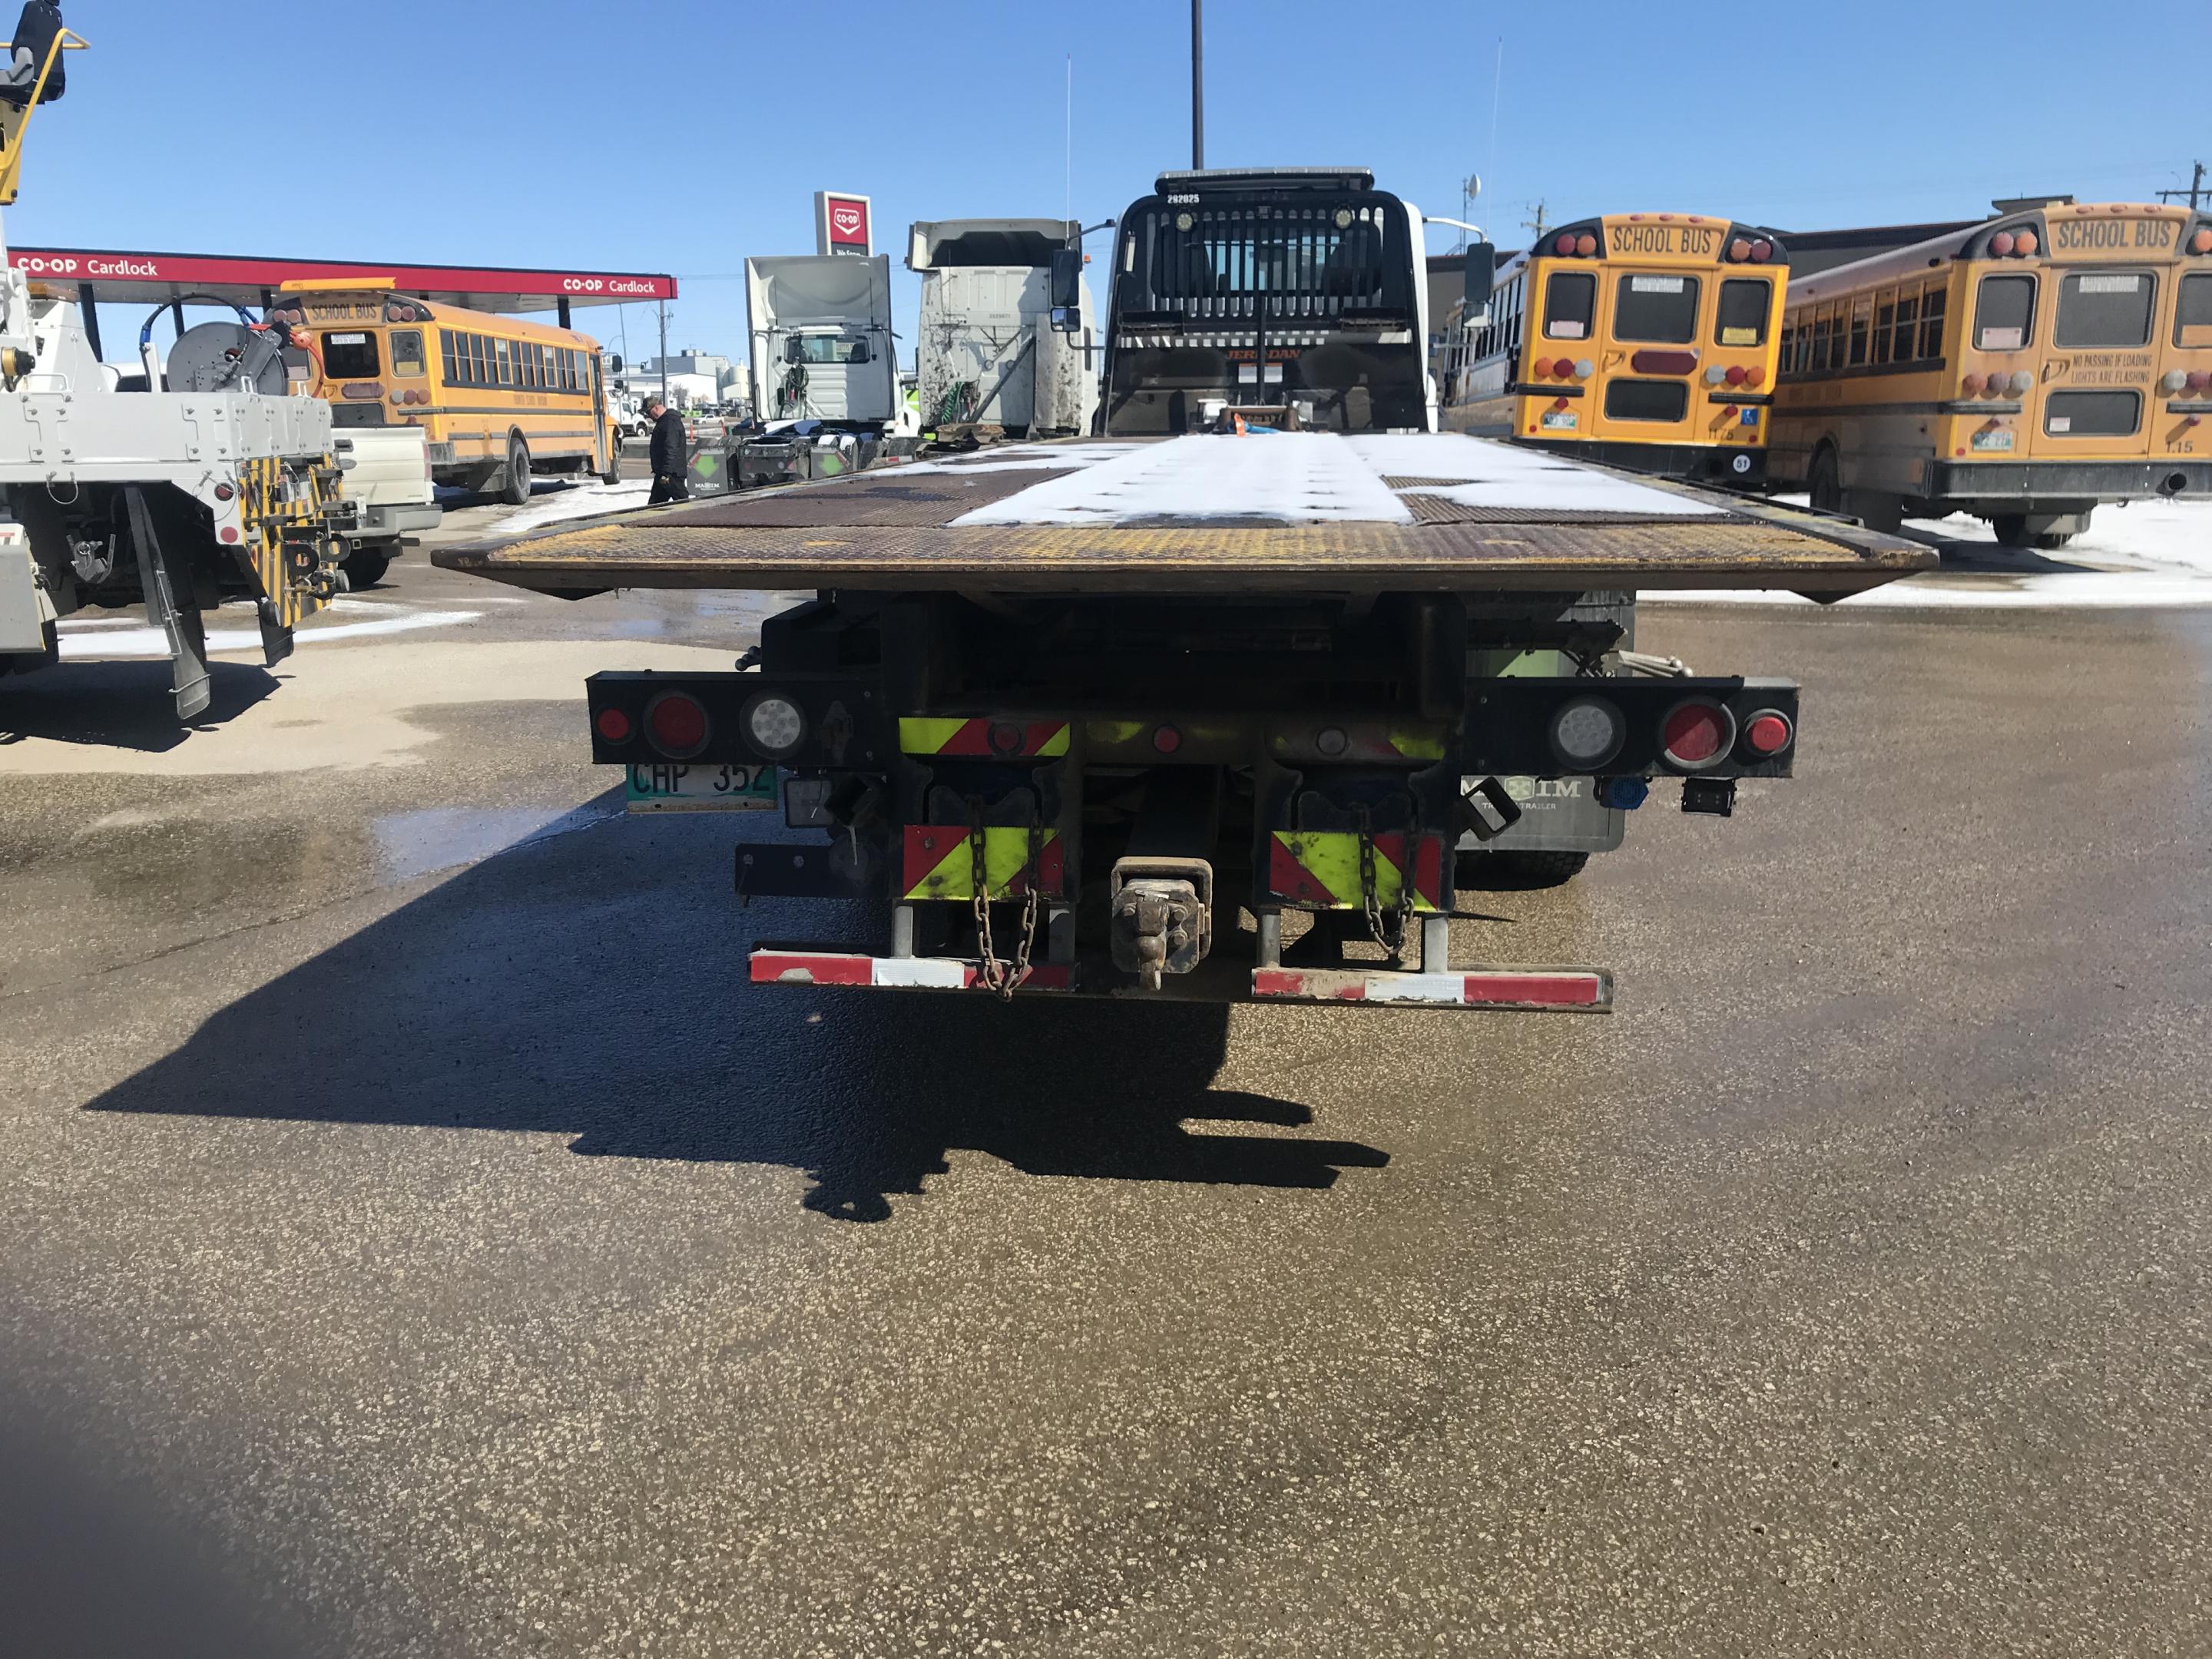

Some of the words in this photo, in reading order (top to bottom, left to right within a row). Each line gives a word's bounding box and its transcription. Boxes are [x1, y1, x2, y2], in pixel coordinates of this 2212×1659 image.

[1613, 226, 1674, 253] SCHOOL
[1681, 227, 1712, 254] BUS
[2058, 220, 2129, 248] SCHOOL
[2134, 220, 2171, 247] BUS
[88, 260, 159, 276] Cardlock
[609, 280, 655, 293] Cardlock
[311, 303, 354, 321] SCHOOL
[356, 302, 377, 320] BUS
[2072, 354, 2083, 367] NO
[2084, 354, 2114, 367] PASSING
[2114, 354, 2121, 367] IF
[2122, 354, 2152, 367] LOADING
[2071, 370, 2097, 383] LIGHTS
[2098, 370, 2113, 383] ARE
[2114, 370, 2151, 383] FLASHING
[633, 763, 689, 793] CHP
[713, 763, 771, 792] 352
